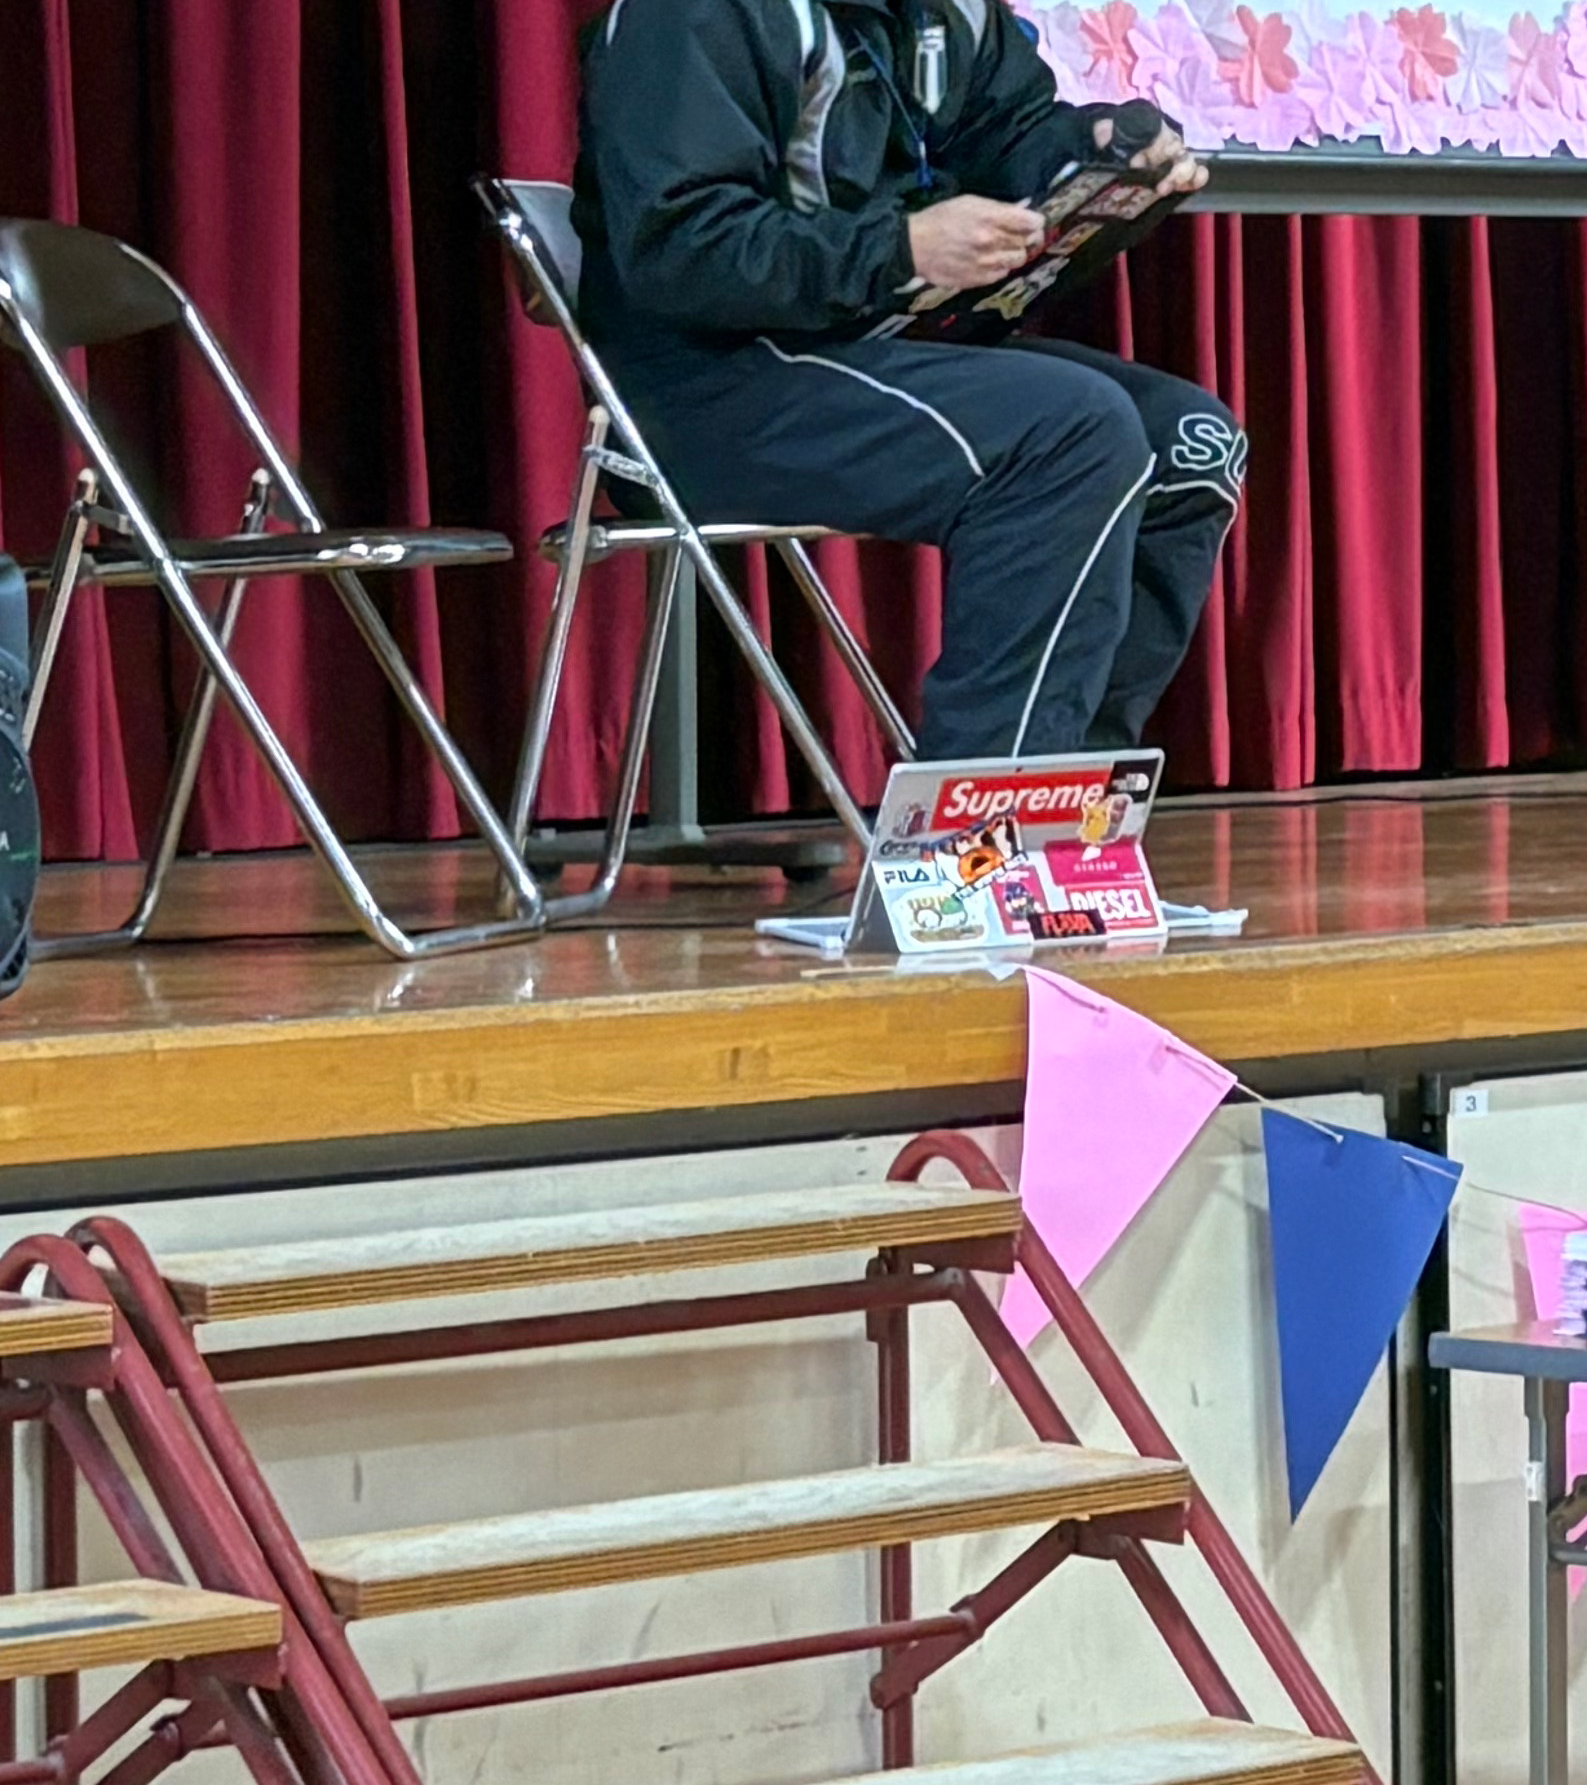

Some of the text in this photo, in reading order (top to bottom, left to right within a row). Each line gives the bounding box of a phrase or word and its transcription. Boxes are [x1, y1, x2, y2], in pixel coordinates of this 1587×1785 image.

[943, 779, 1105, 821] Supreme
[884, 867, 930, 884] FILA
[1069, 888, 1151, 921] DIESEL
[1465, 1095, 1477, 1113] 3
